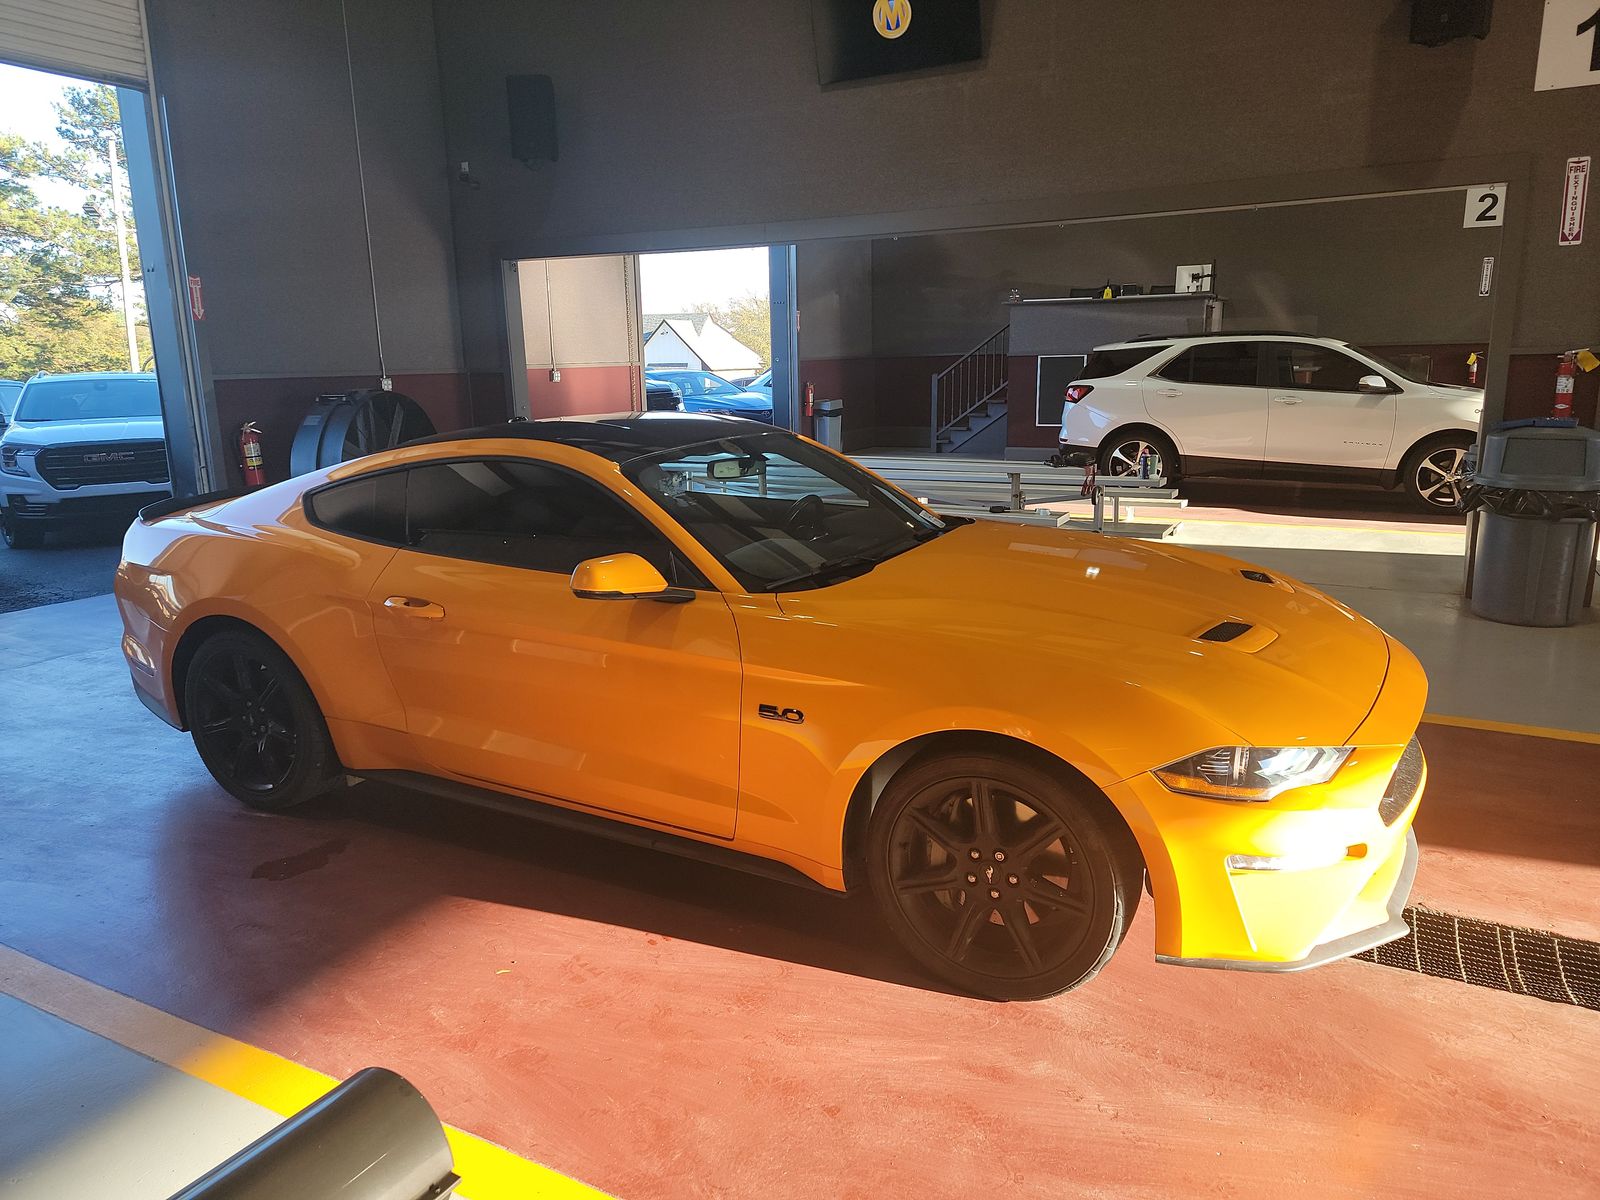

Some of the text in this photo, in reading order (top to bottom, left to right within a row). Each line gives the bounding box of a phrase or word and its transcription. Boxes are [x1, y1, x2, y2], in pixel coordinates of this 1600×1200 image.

[1569, 164, 1587, 174] FIRE
[1475, 192, 1499, 222] 2
[1567, 174, 1580, 238] EXTINGUISHER
[83, 451, 135, 464] GMC
[758, 703, 805, 725] 5.0
